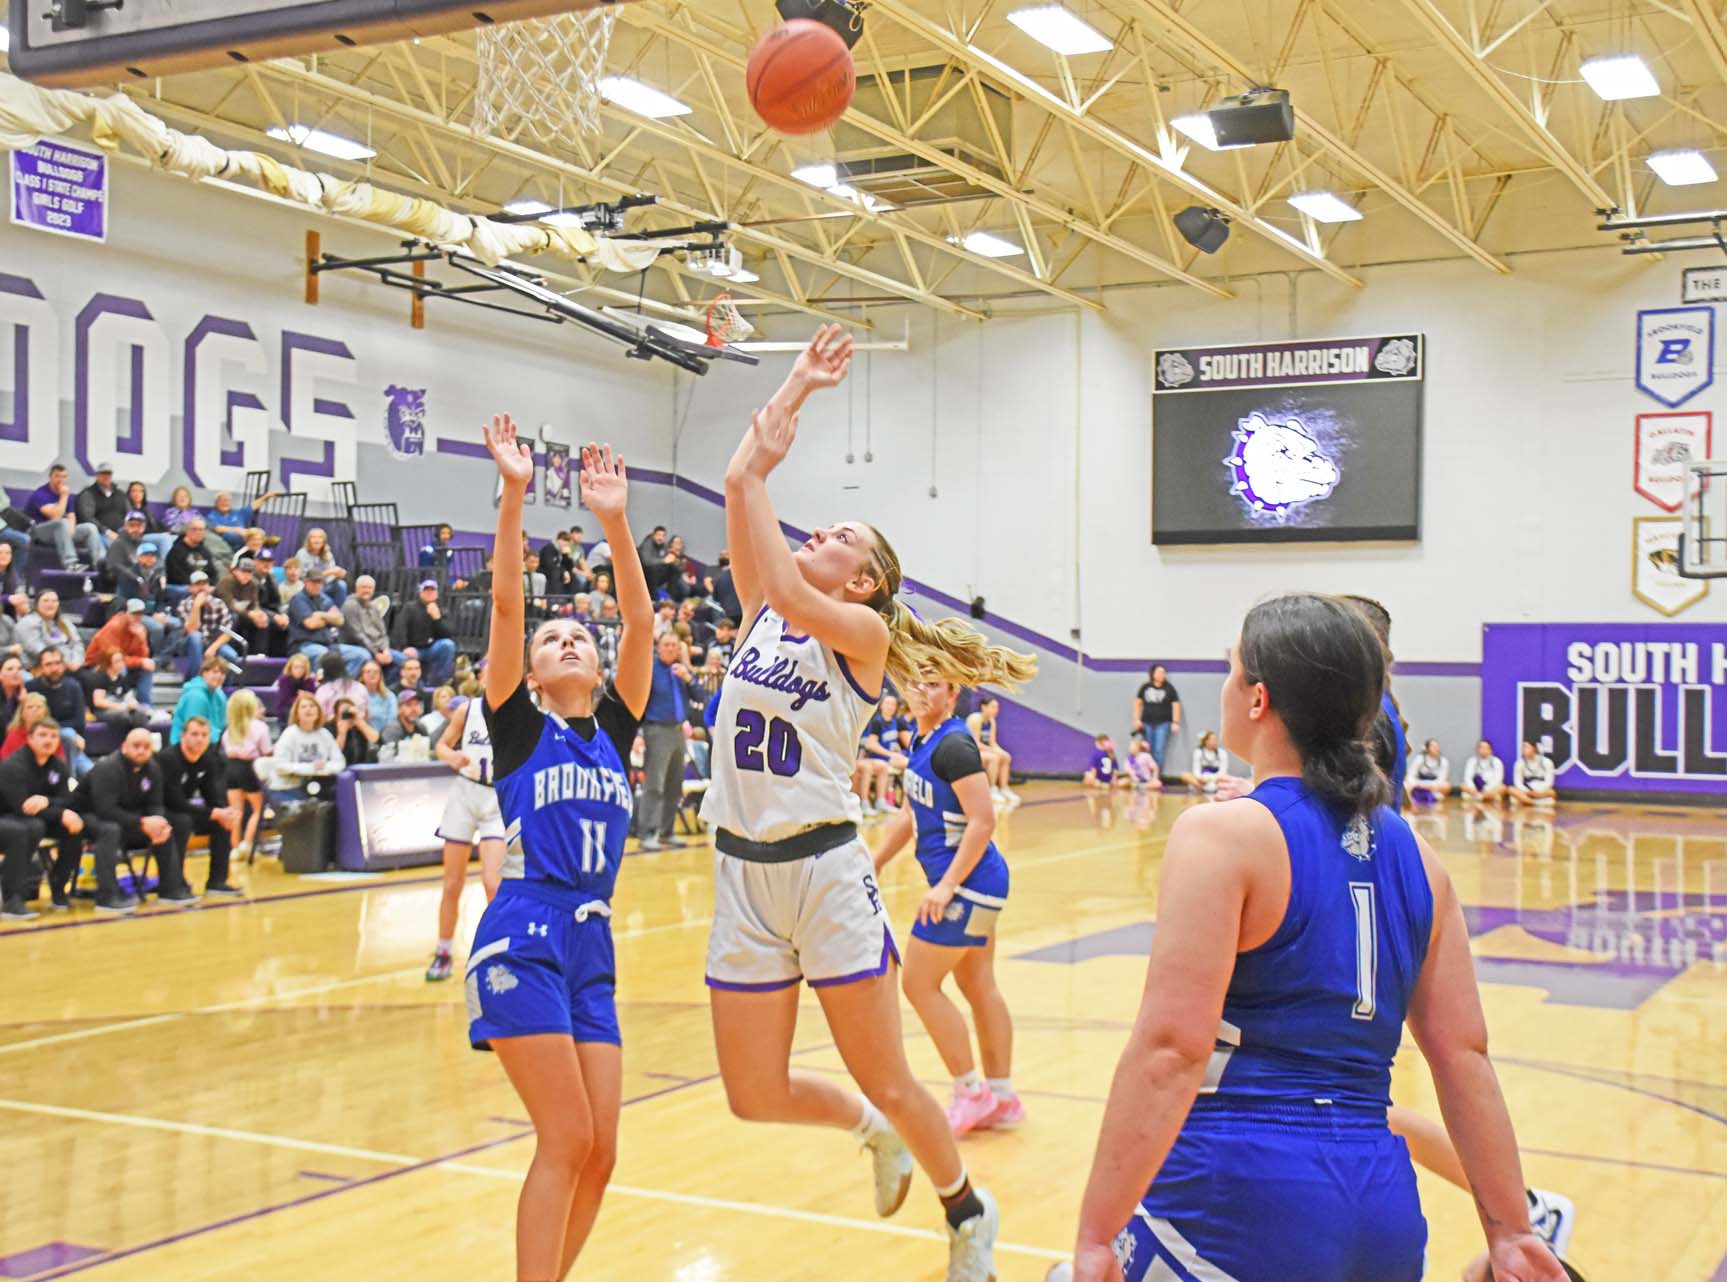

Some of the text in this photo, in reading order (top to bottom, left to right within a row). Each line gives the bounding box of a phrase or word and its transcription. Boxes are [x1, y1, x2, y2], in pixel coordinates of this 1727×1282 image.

[16, 172, 41, 188] CLASS
[47, 179, 71, 195] STATE
[71, 185, 104, 202] CHAMPS
[37, 160, 84, 182] BULLDOGS
[33, 192, 84, 214] GIRLS GOLF
[46, 211, 71, 227] 2023
[1692, 279, 1720, 290] THE
[1200, 347, 1369, 380] SOUTH HARRISON
[1655, 338, 1692, 364] B
[730, 647, 831, 711] Bulldogs
[1567, 642, 1698, 685] SOUTH
[734, 708, 802, 777] 20
[1517, 682, 1727, 780] BULL
[579, 818, 607, 873] 11
[1349, 882, 1377, 1021] 1
